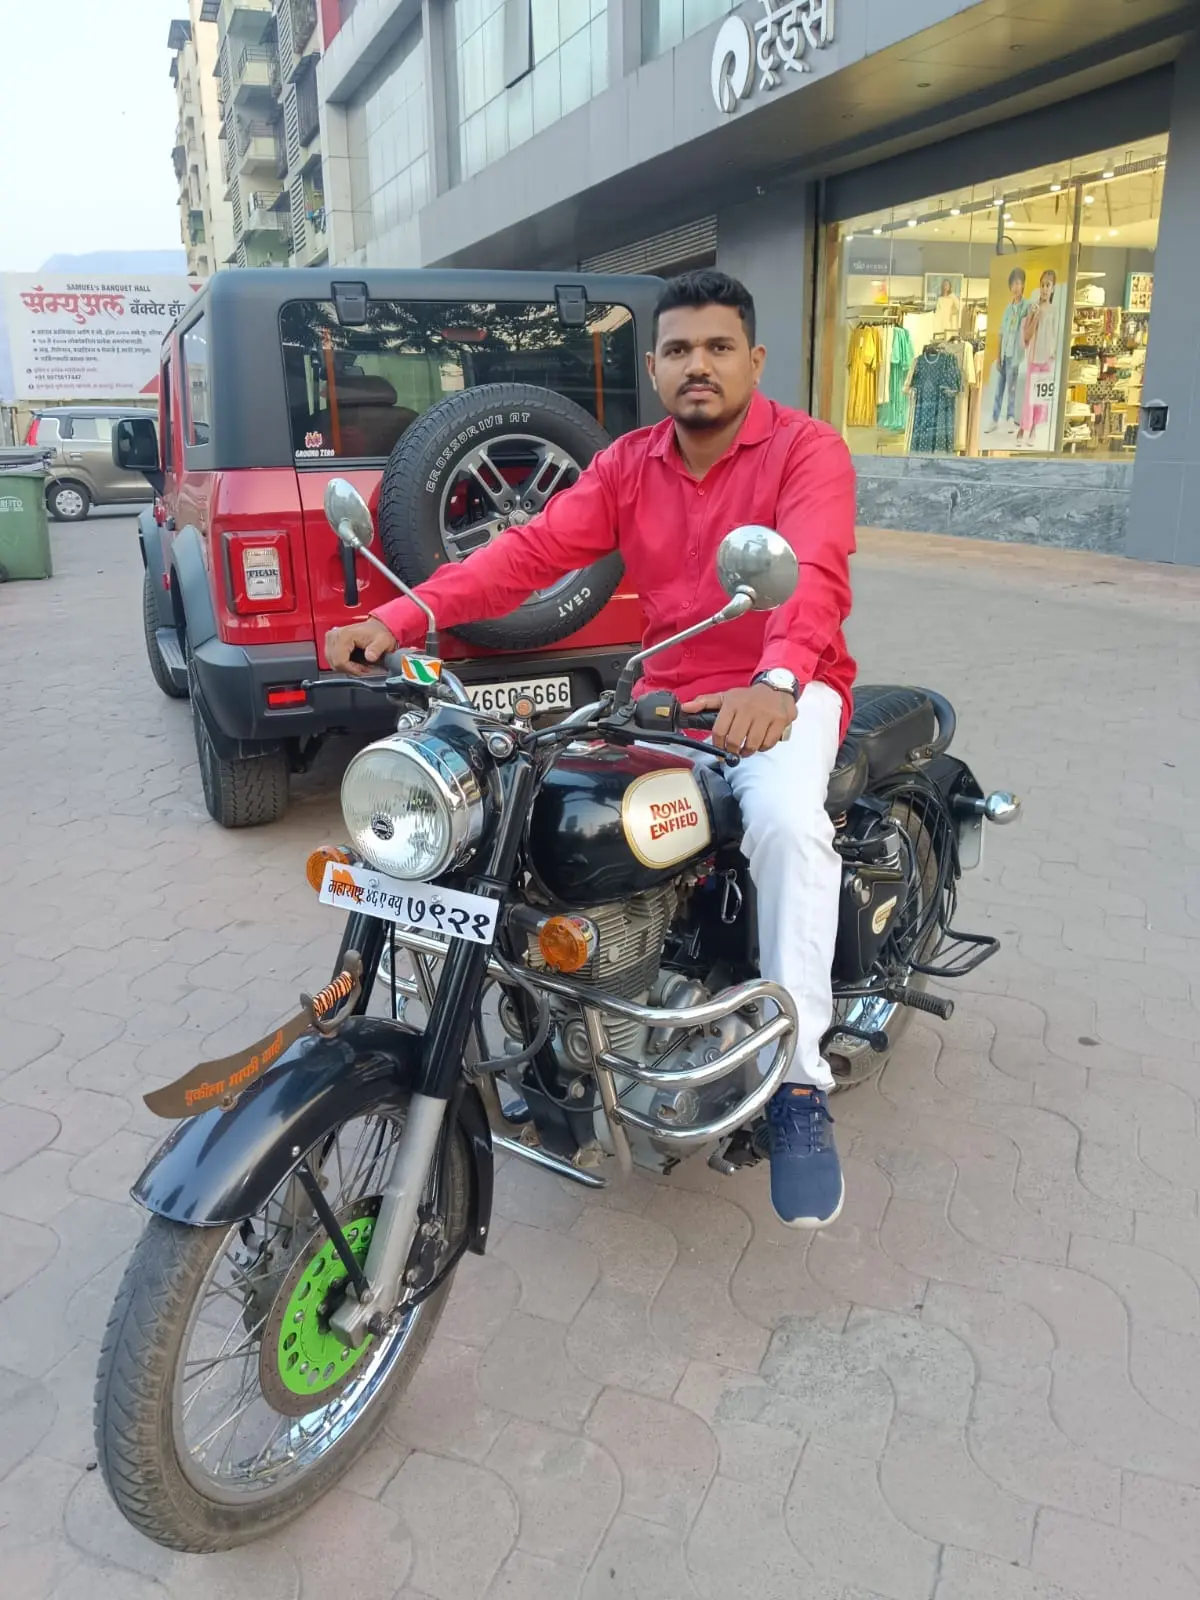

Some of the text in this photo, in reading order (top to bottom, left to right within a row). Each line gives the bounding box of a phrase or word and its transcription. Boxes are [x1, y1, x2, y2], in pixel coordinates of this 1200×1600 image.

[101, 284, 132, 292] BANQUET
[168, 300, 186, 317] हॉ
[425, 412, 531, 494] CROSSDRIVE AT
[558, 587, 591, 618] CEAT
[650, 798, 691, 820] ROYAL
[650, 812, 698, 840] ENFIELD
